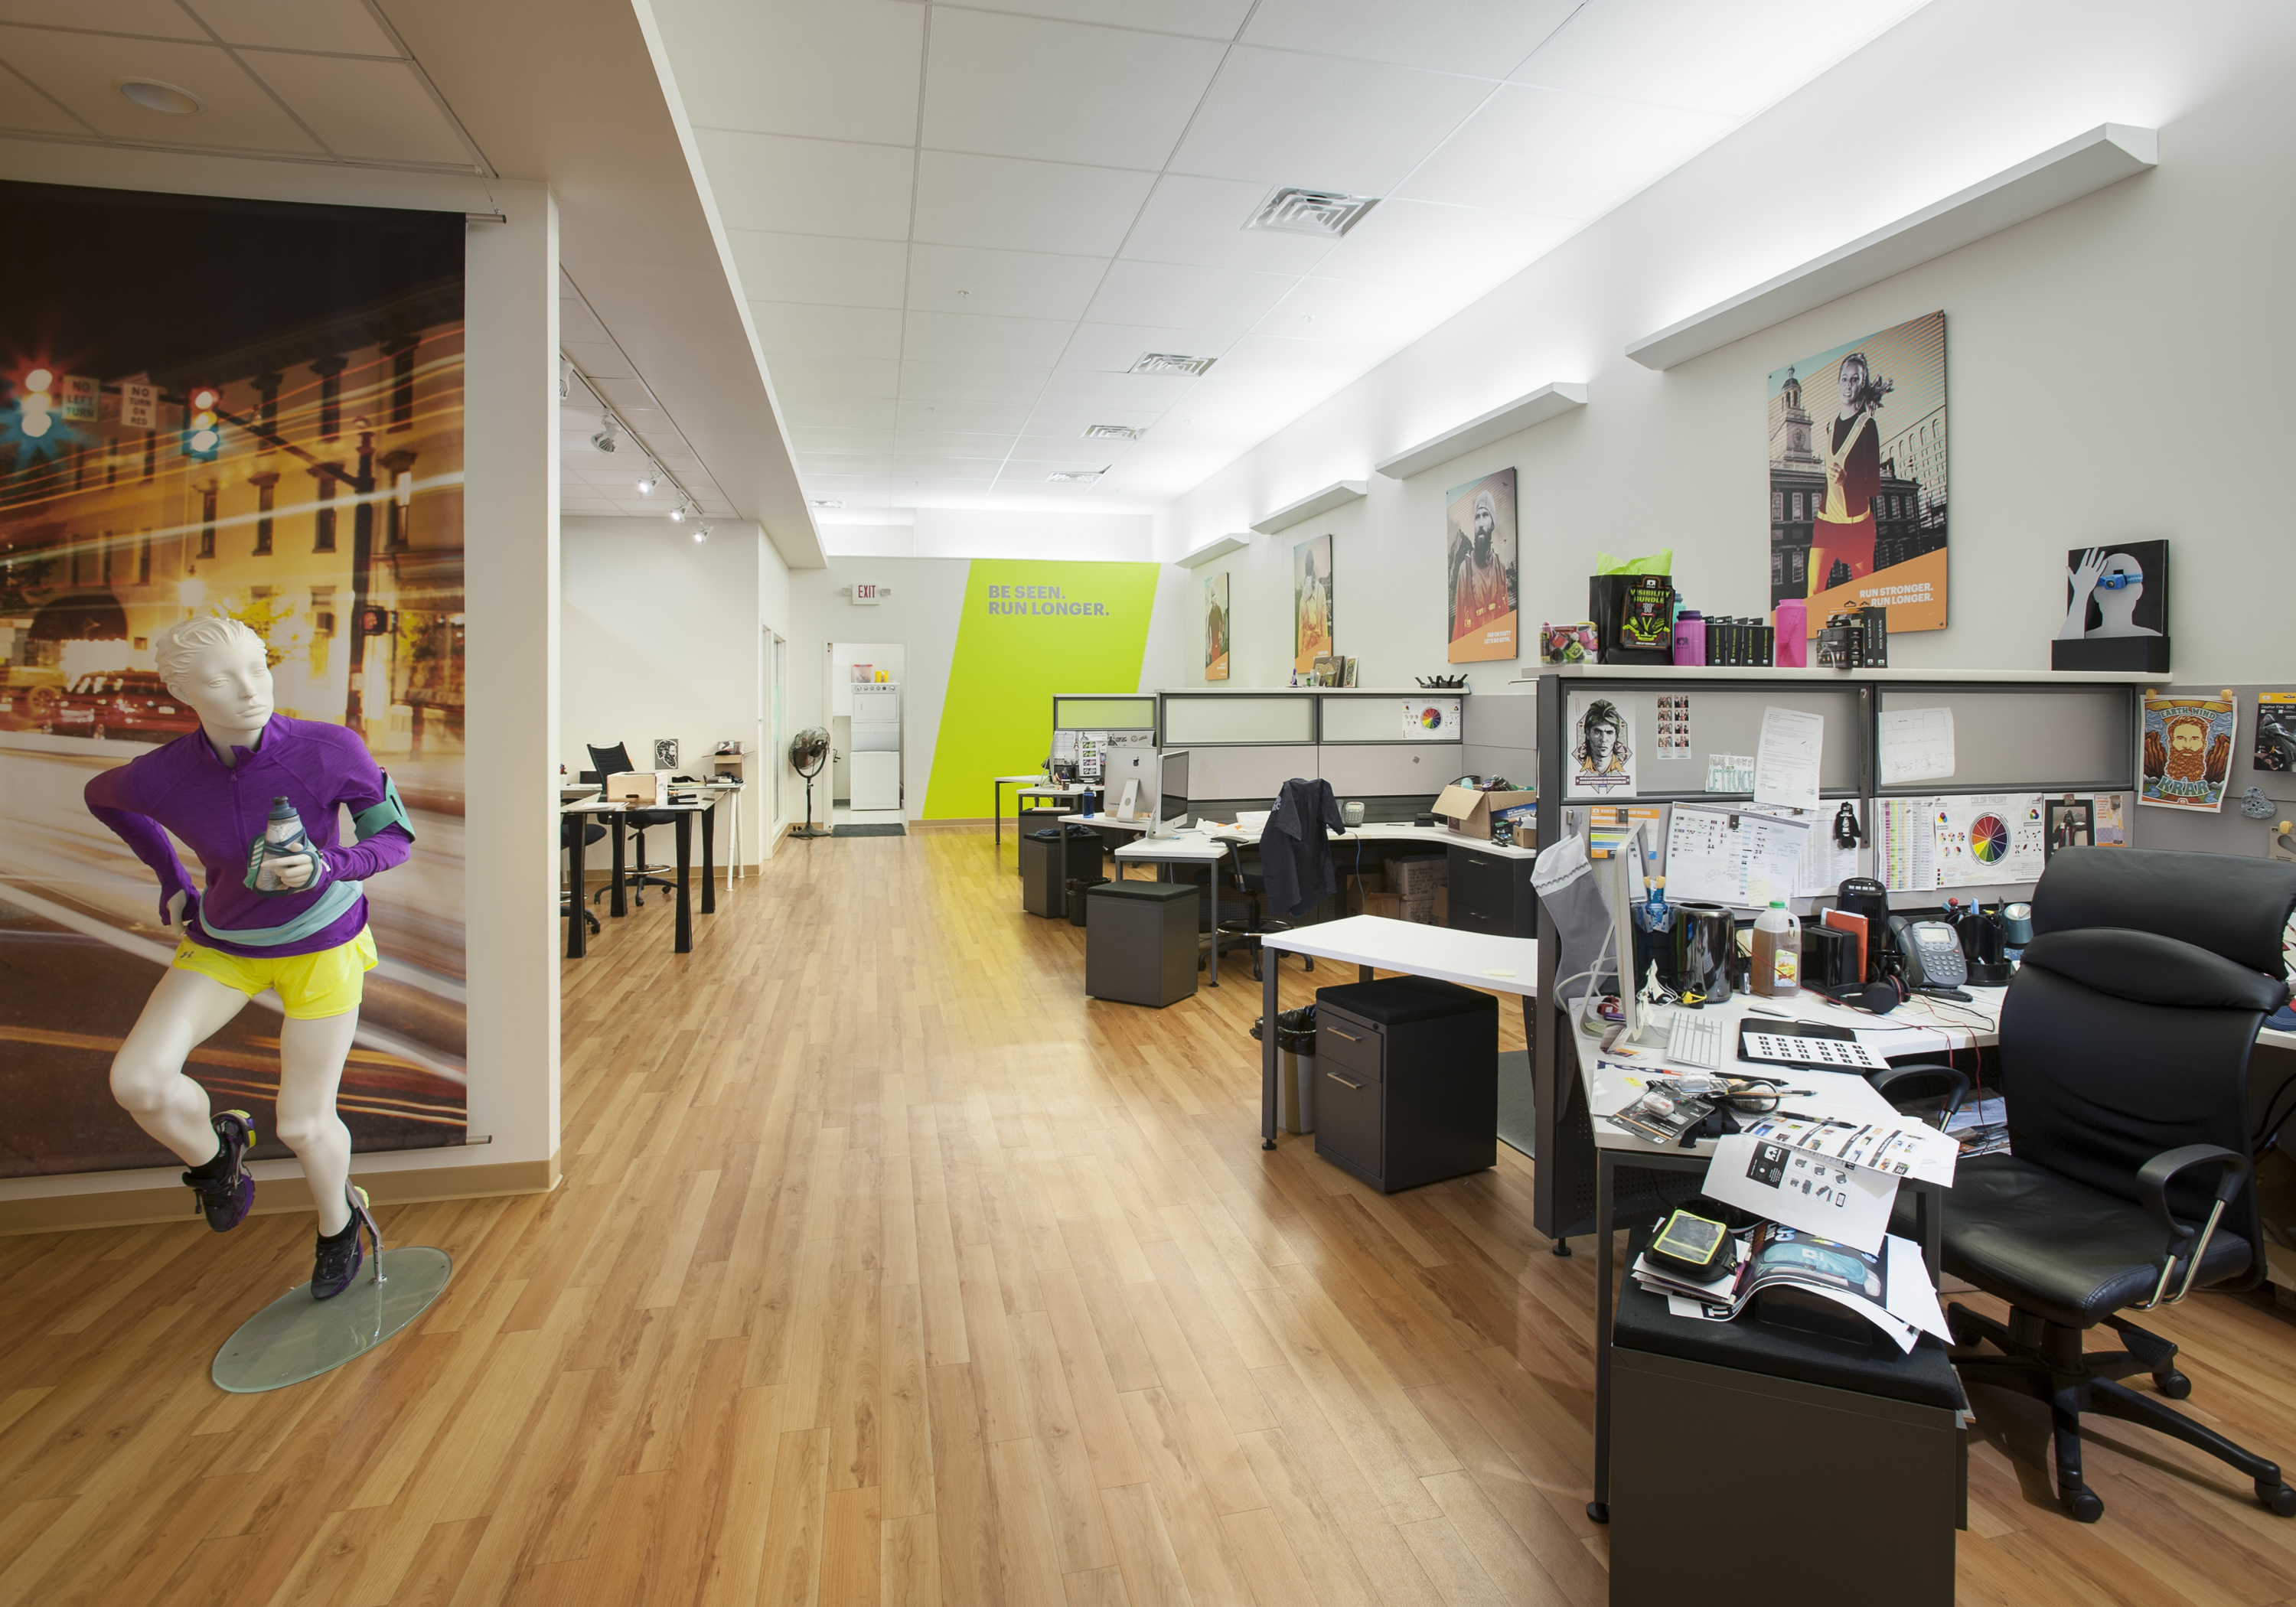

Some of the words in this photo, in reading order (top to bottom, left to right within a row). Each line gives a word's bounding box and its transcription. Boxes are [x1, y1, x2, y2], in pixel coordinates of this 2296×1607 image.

[73, 381, 90, 392] NO
[132, 386, 149, 396] NO
[68, 394, 93, 405] LEFT
[129, 397, 151, 406] TURN
[67, 406, 94, 418] TURN
[133, 407, 146, 416] ON
[131, 417, 148, 425] RED
[858, 585, 876, 598] EXIT
[989, 585, 1011, 598] BE
[1014, 585, 1066, 599] SEEN.
[1860, 588, 1879, 598] RUN
[1880, 582, 1933, 596] STRONGER.
[1870, 597, 1890, 607] RUN
[1891, 593, 1933, 605] LONGER.
[989, 601, 1027, 614] RUN
[1032, 602, 1110, 616] LONGER.
[2160, 707, 2191, 718] EARTH,
[2192, 708, 2216, 719] WIND
[1707, 769, 1753, 791] LETTUCE
[2157, 777, 2210, 796] KRAR
